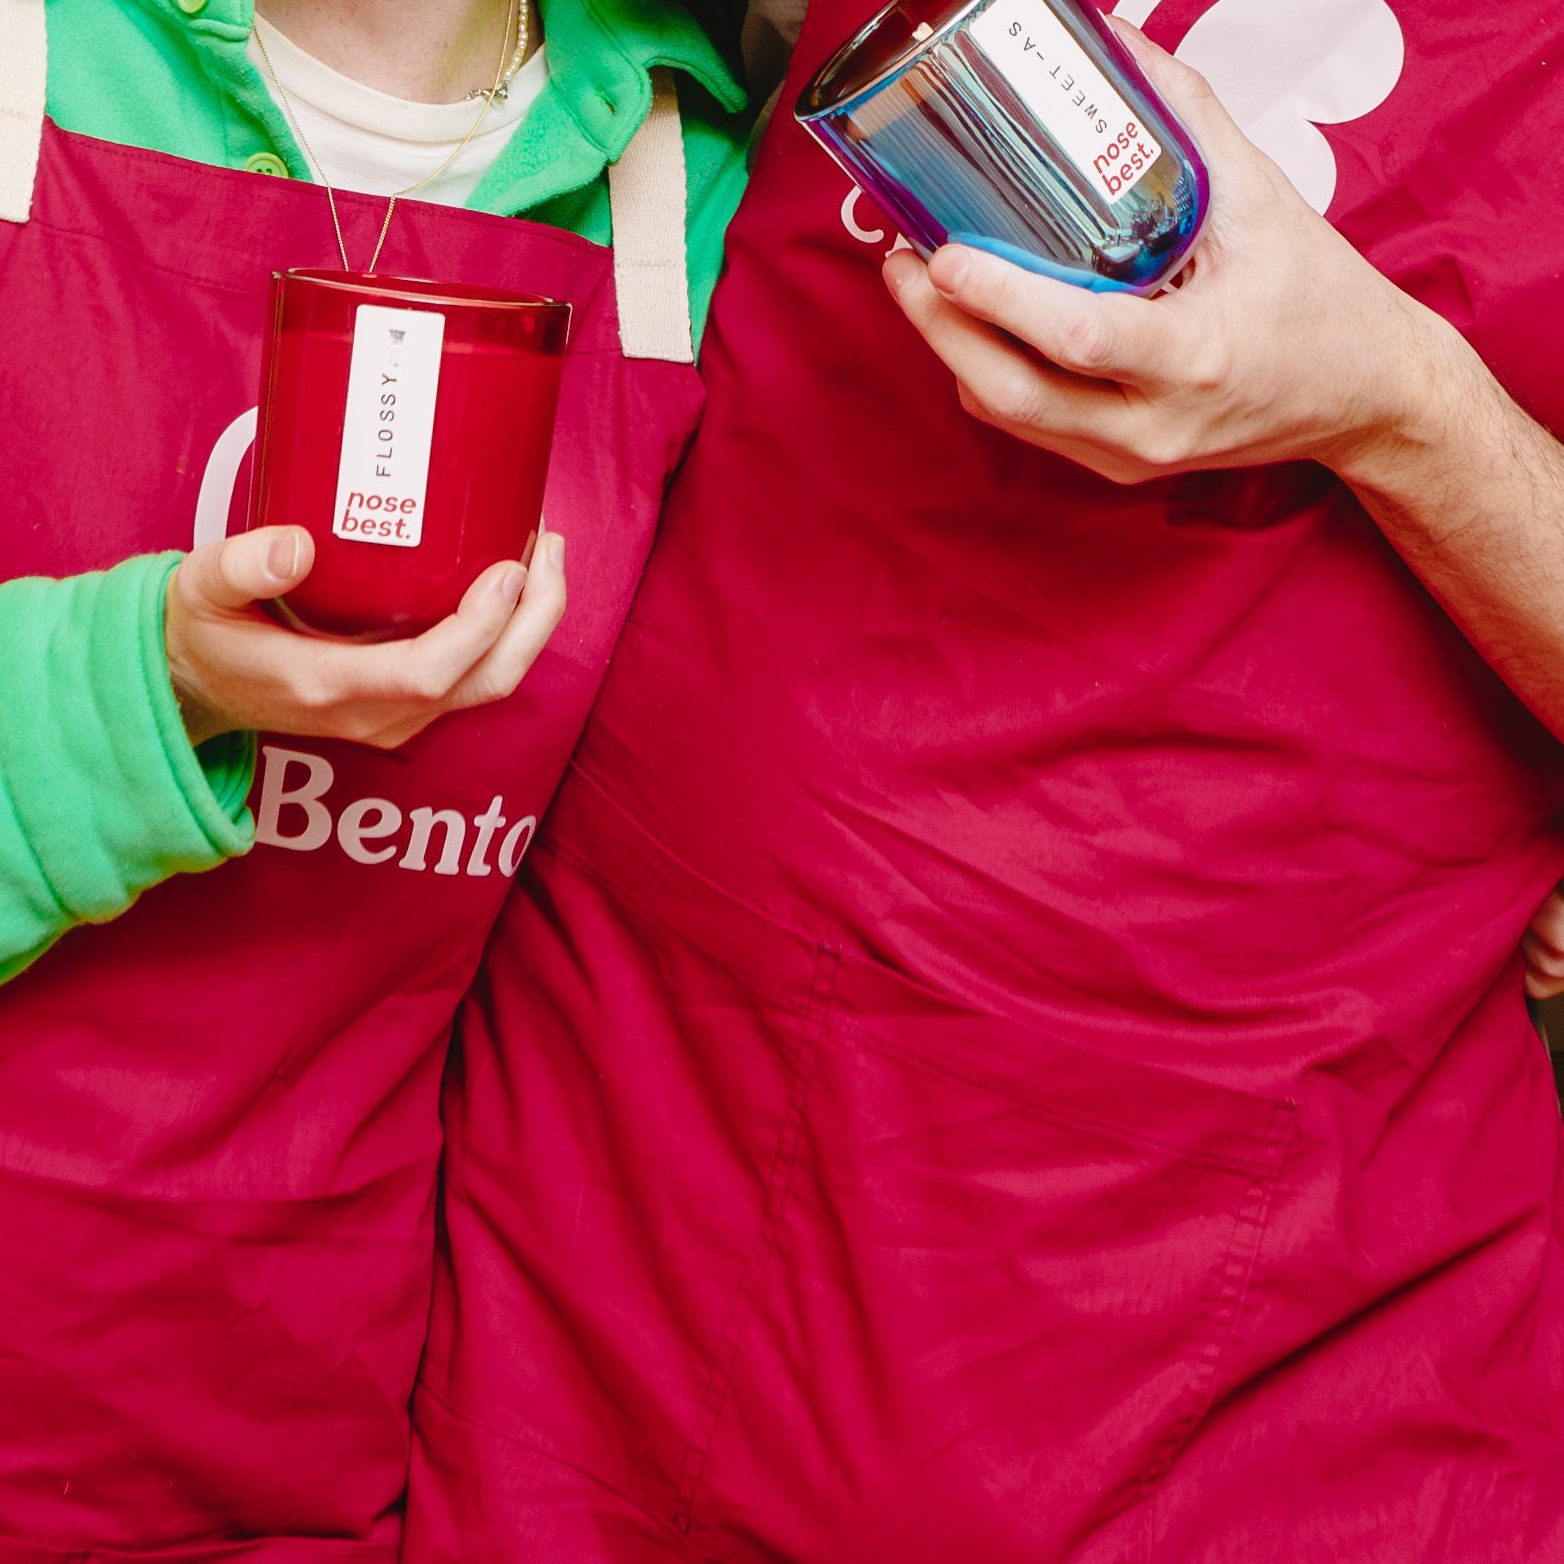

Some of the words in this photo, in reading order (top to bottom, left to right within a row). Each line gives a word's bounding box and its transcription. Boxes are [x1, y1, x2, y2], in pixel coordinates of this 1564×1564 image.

[1008, 21, 1108, 134] SWEET-AS
[1092, 121, 1139, 175] nose
[1102, 142, 1155, 196] best.
[376, 373, 398, 478] FLOSSY
[341, 508, 411, 540] best.
[347, 491, 417, 515] nose
